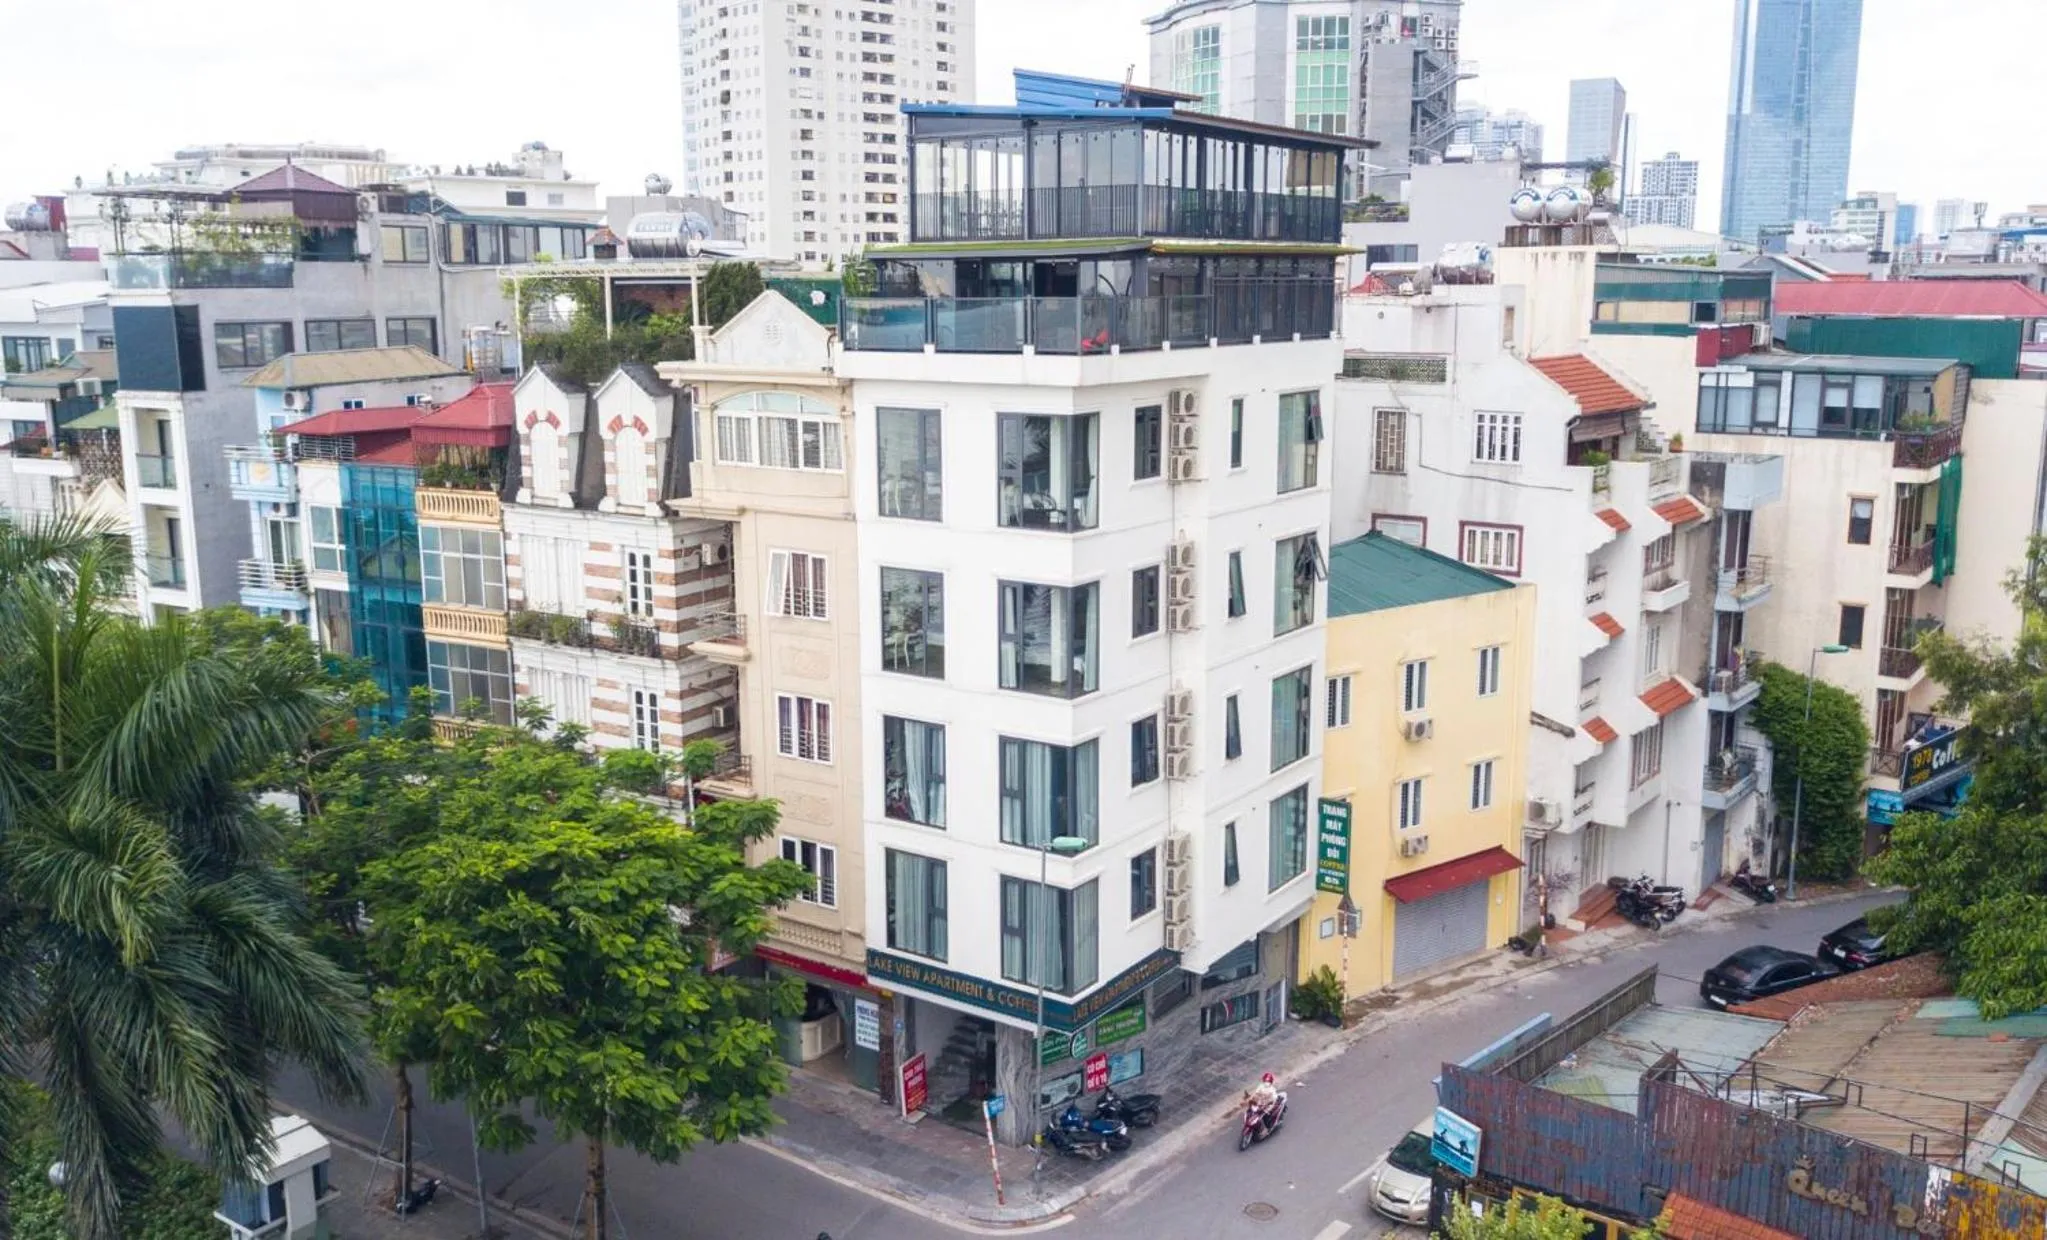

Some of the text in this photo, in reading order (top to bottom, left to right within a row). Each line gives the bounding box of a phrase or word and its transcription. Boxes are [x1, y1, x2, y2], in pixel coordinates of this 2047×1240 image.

[868, 955, 893, 973] LAKE
[896, 962, 920, 980] VIEW
[923, 970, 983, 998] APARTMENT
